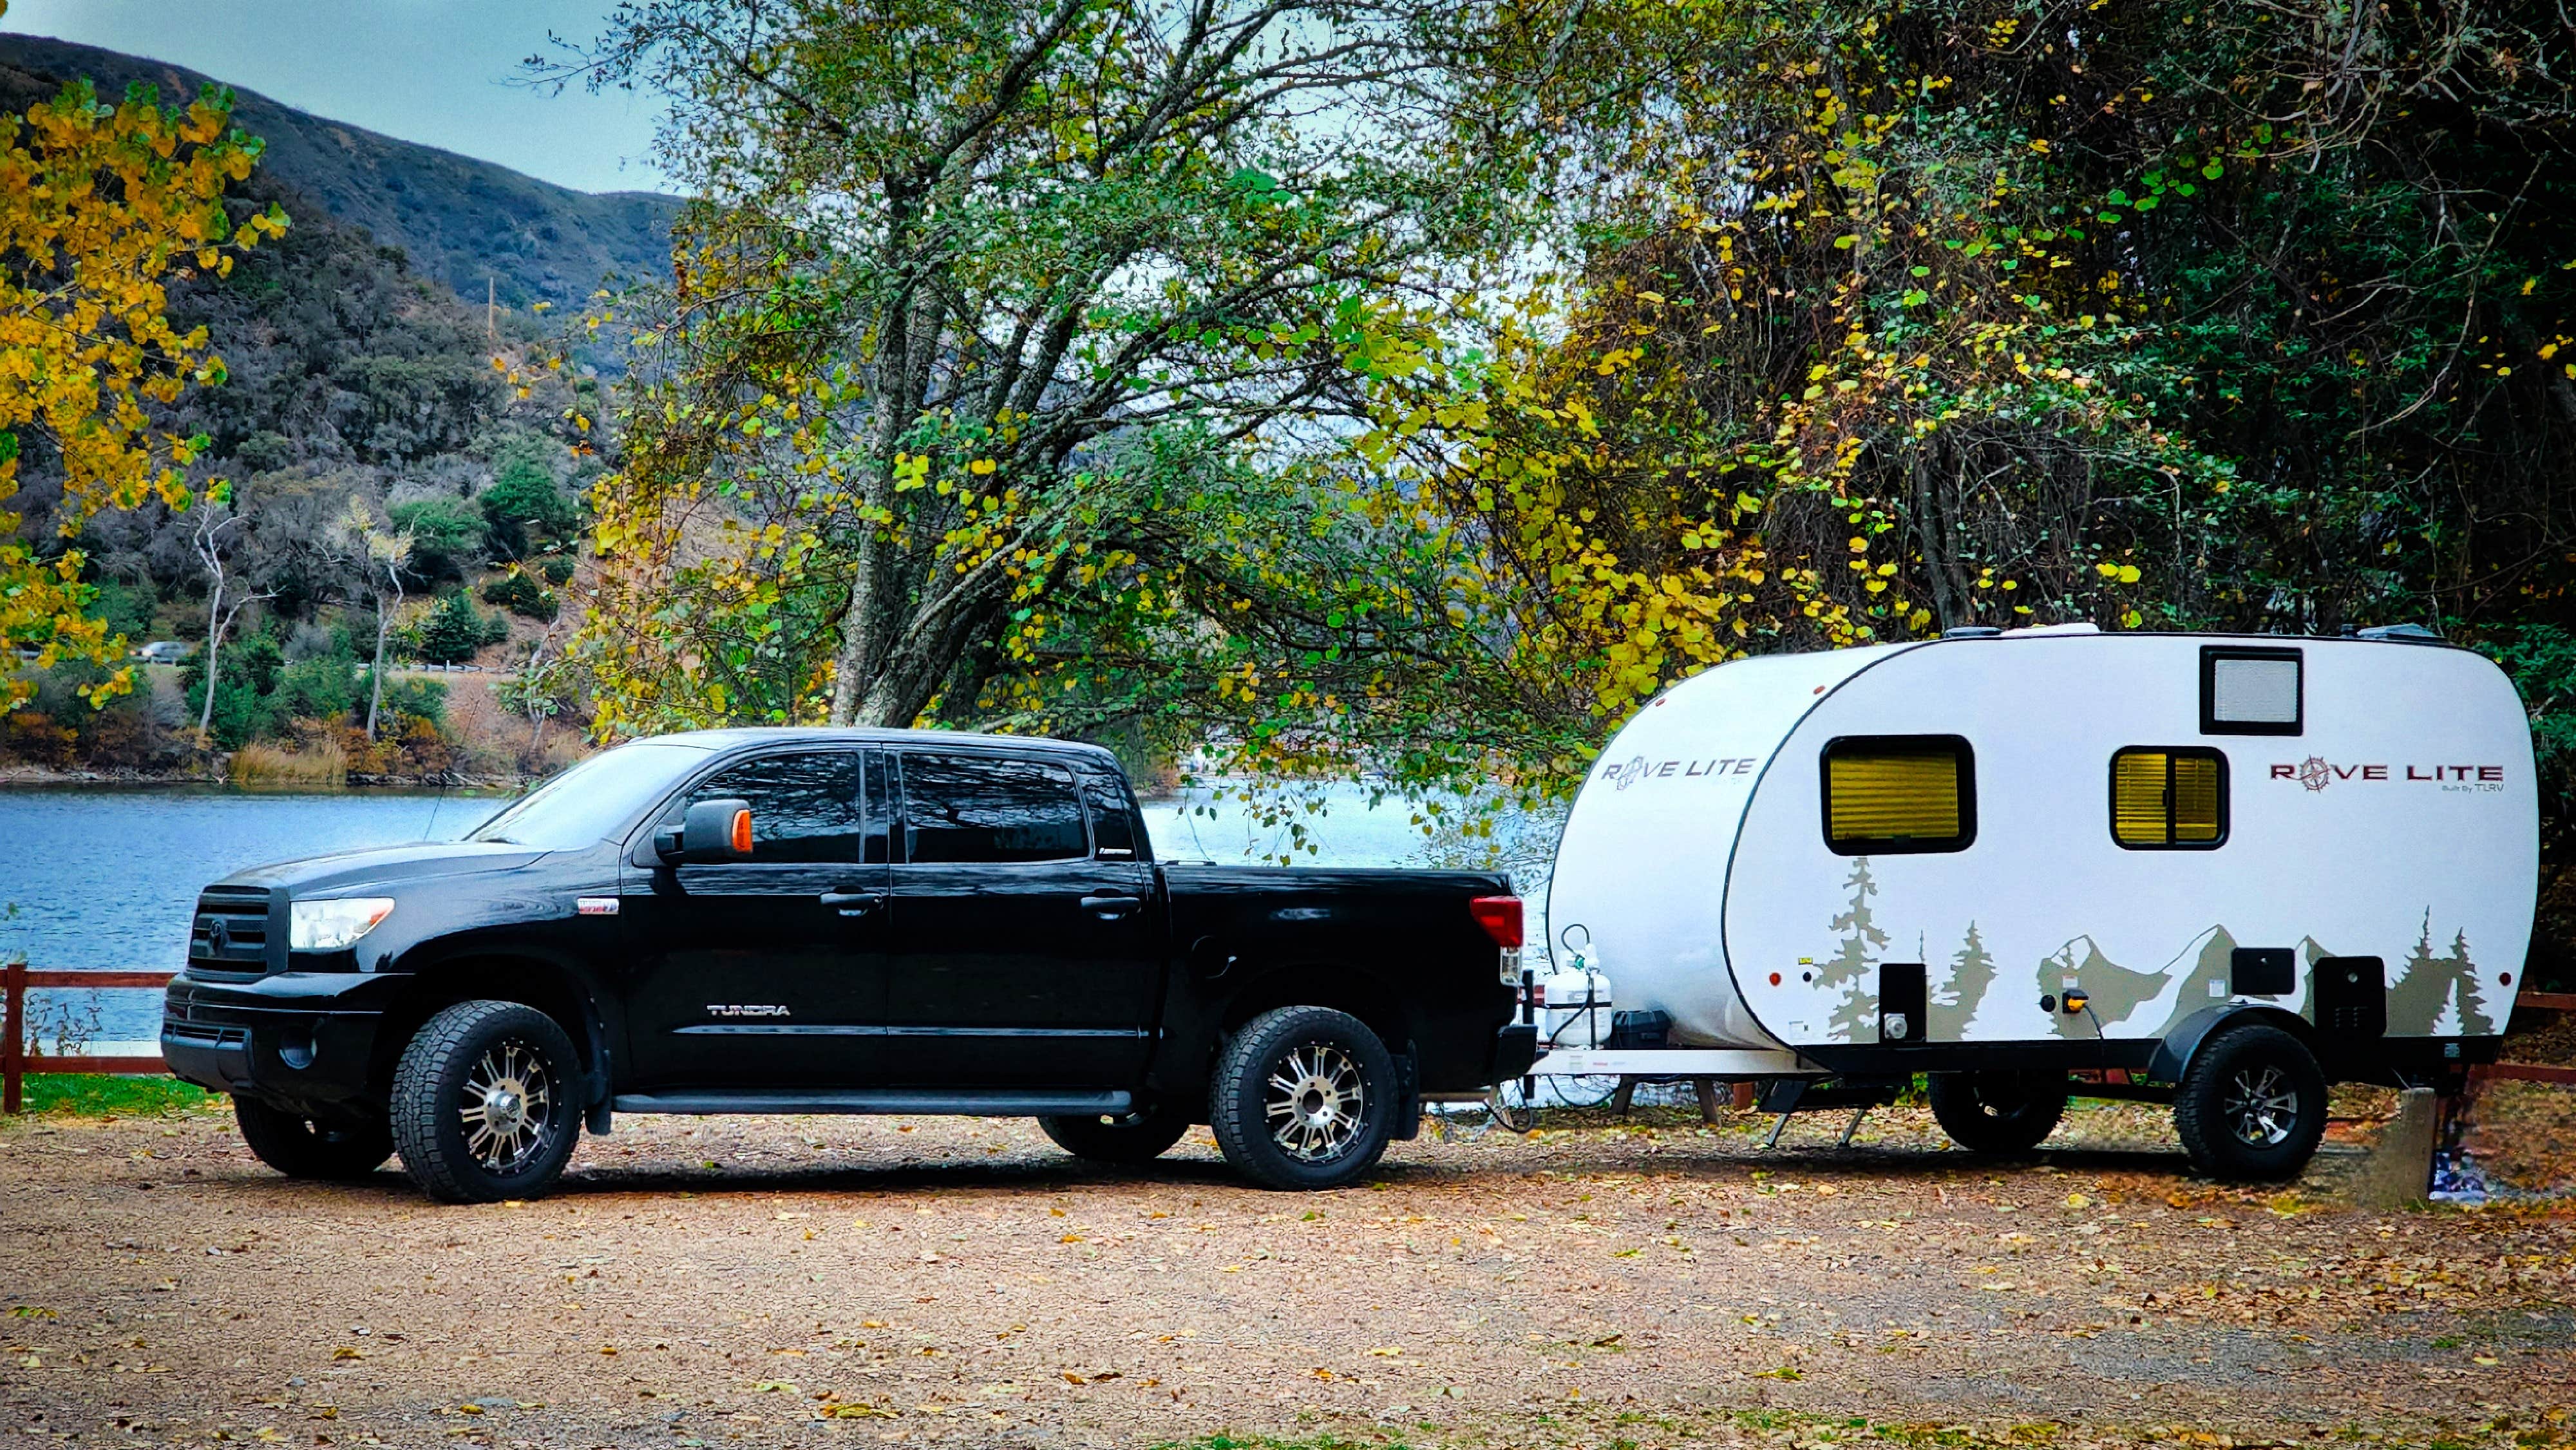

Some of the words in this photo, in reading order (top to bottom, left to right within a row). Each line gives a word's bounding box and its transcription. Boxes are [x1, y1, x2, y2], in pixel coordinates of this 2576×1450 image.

[1685, 758, 1756, 777] LITE
[2407, 766, 2503, 780] LITE
[2474, 784, 2504, 792] TLRV
[706, 1005, 791, 1016] TUNDRA
